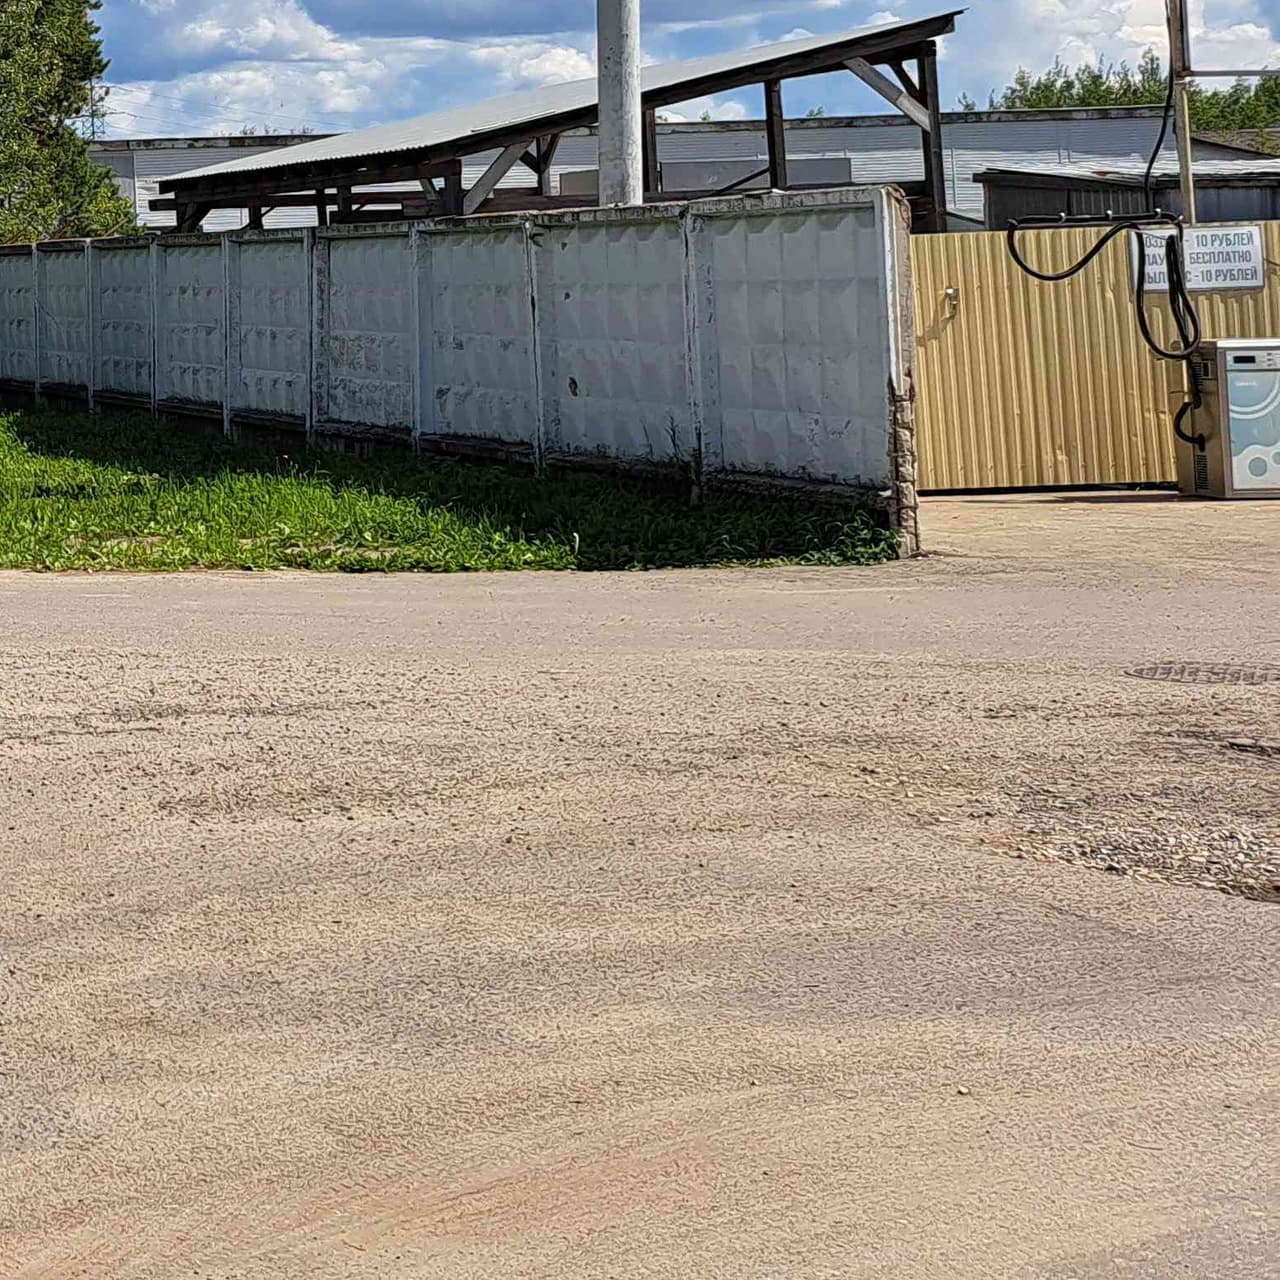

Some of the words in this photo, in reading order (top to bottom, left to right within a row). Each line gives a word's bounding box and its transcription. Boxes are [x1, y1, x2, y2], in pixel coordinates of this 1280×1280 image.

[1196, 234, 1208, 247] 10
[1211, 231, 1254, 247] РУБЛЕЙ
[1189, 250, 1252, 265] БЕСПЛАТНО
[1215, 266, 1258, 282] РУБЛЕЙ
